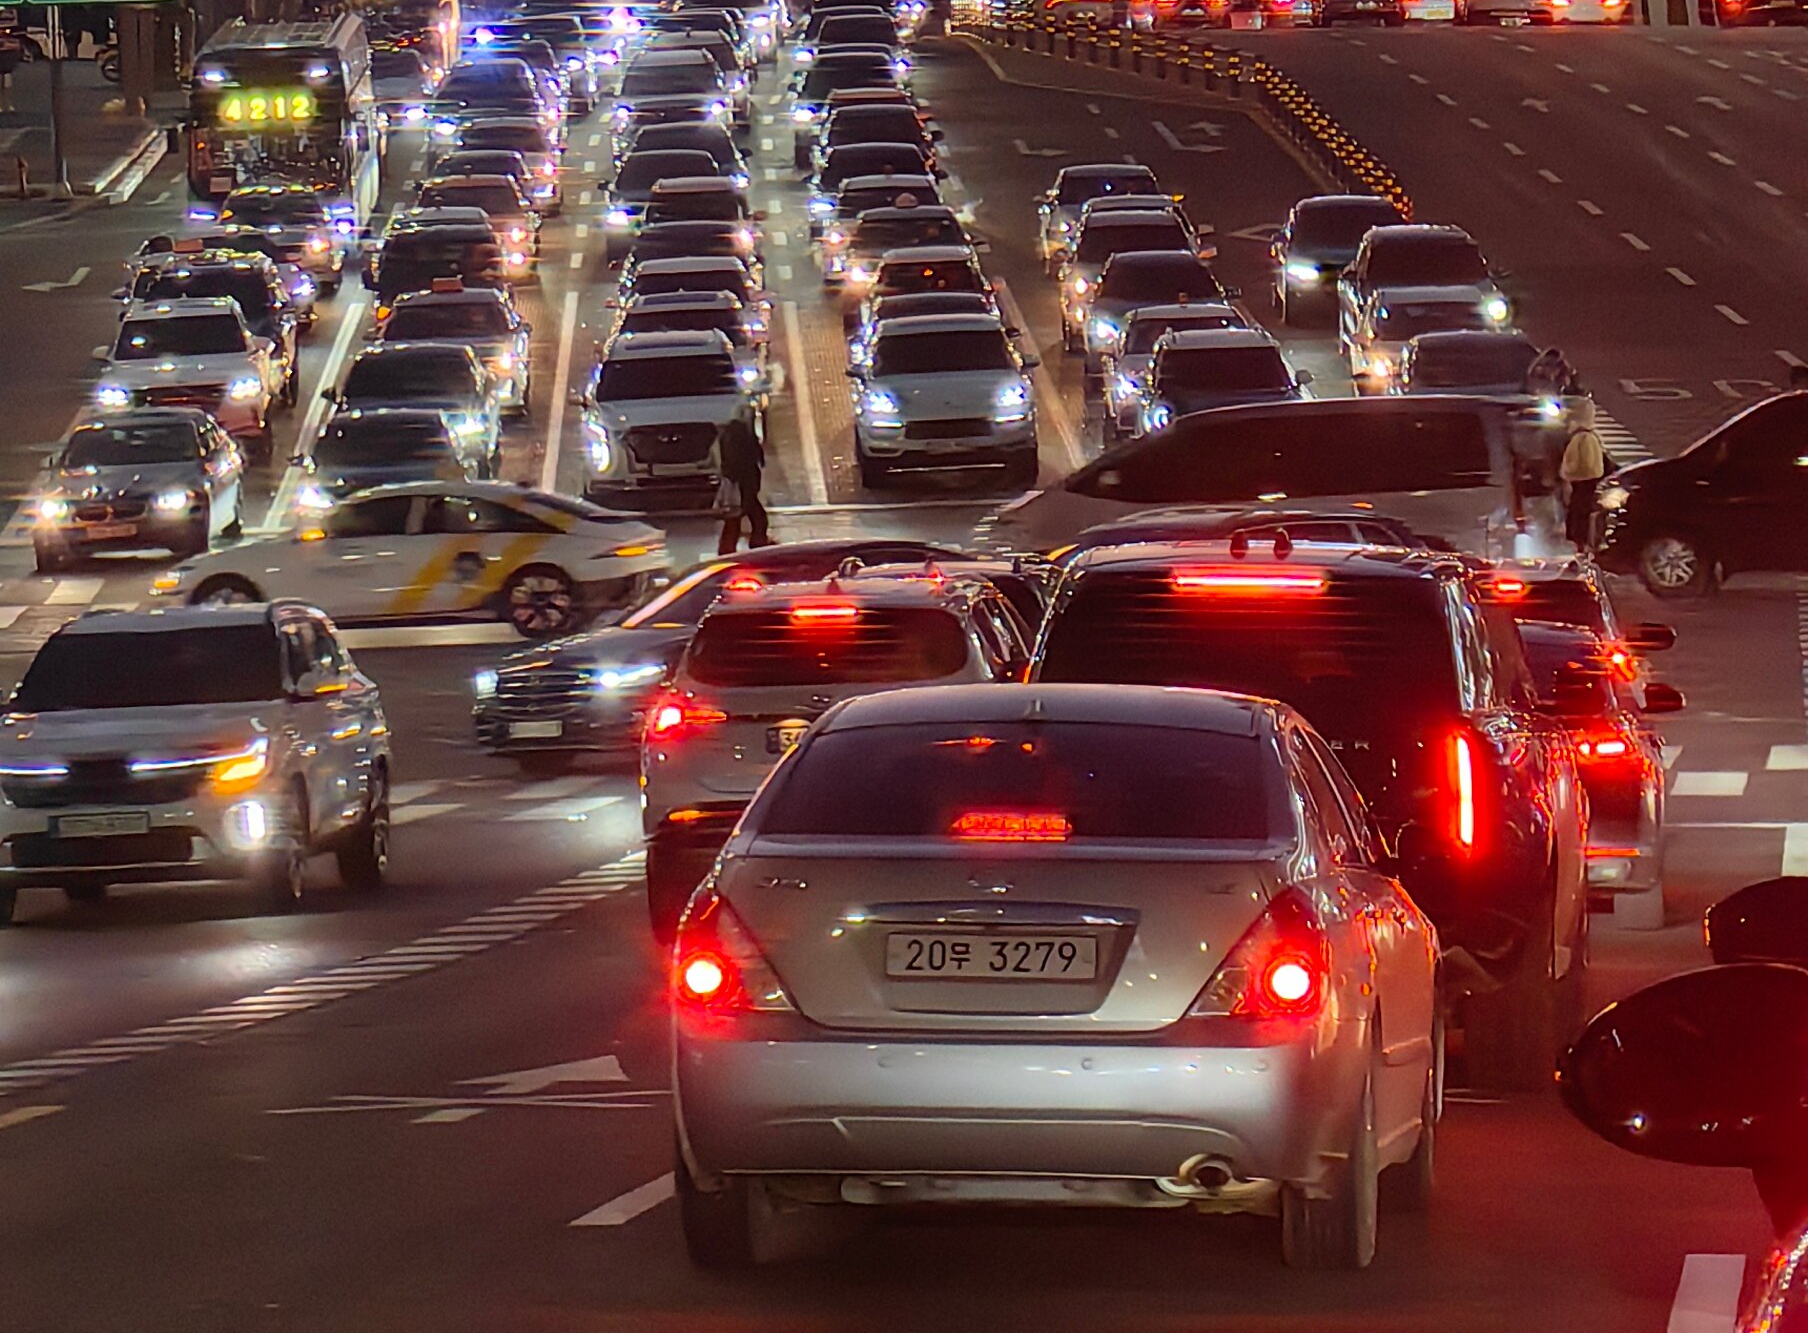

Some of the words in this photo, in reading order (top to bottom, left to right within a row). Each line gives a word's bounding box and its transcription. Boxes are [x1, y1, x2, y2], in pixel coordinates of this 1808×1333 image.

[225, 96, 311, 120] 4212
[905, 939, 971, 971] 20무
[989, 941, 1077, 973] 3279
